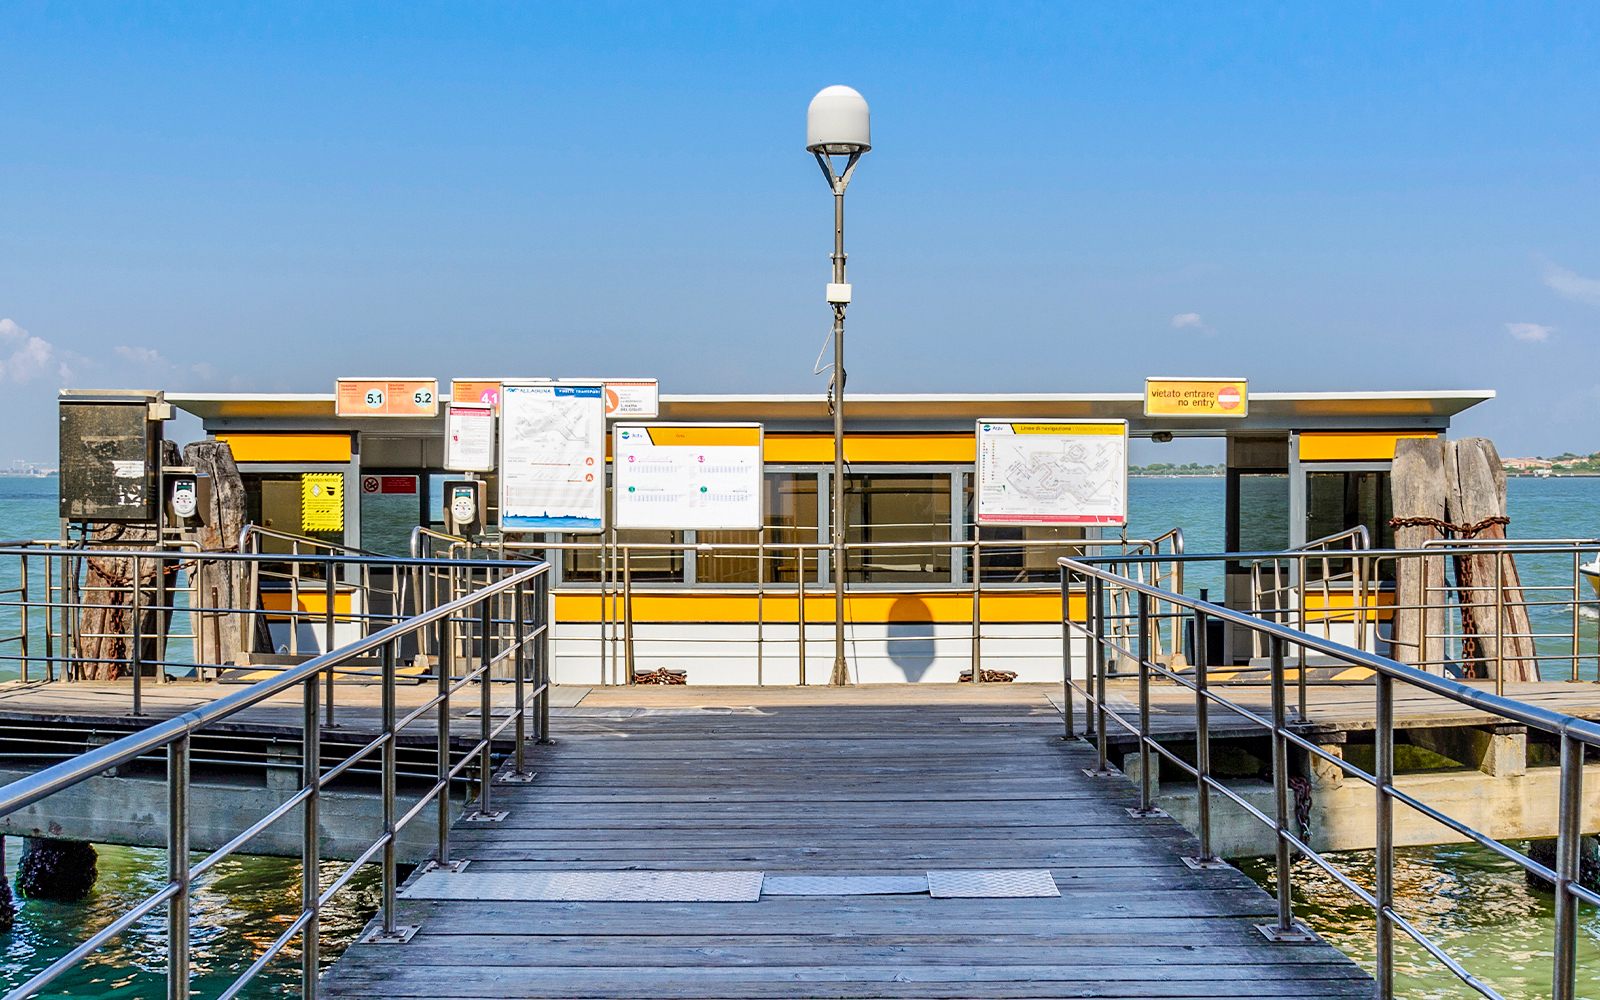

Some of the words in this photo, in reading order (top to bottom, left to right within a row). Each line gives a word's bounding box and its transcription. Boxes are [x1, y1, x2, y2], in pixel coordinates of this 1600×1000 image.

[414, 392, 432, 404] 5.2
[1152, 388, 1180, 398] vietato
[367, 394, 382, 404] 5.1
[481, 393, 498, 404] 4.1
[1192, 399, 1214, 408] entry
